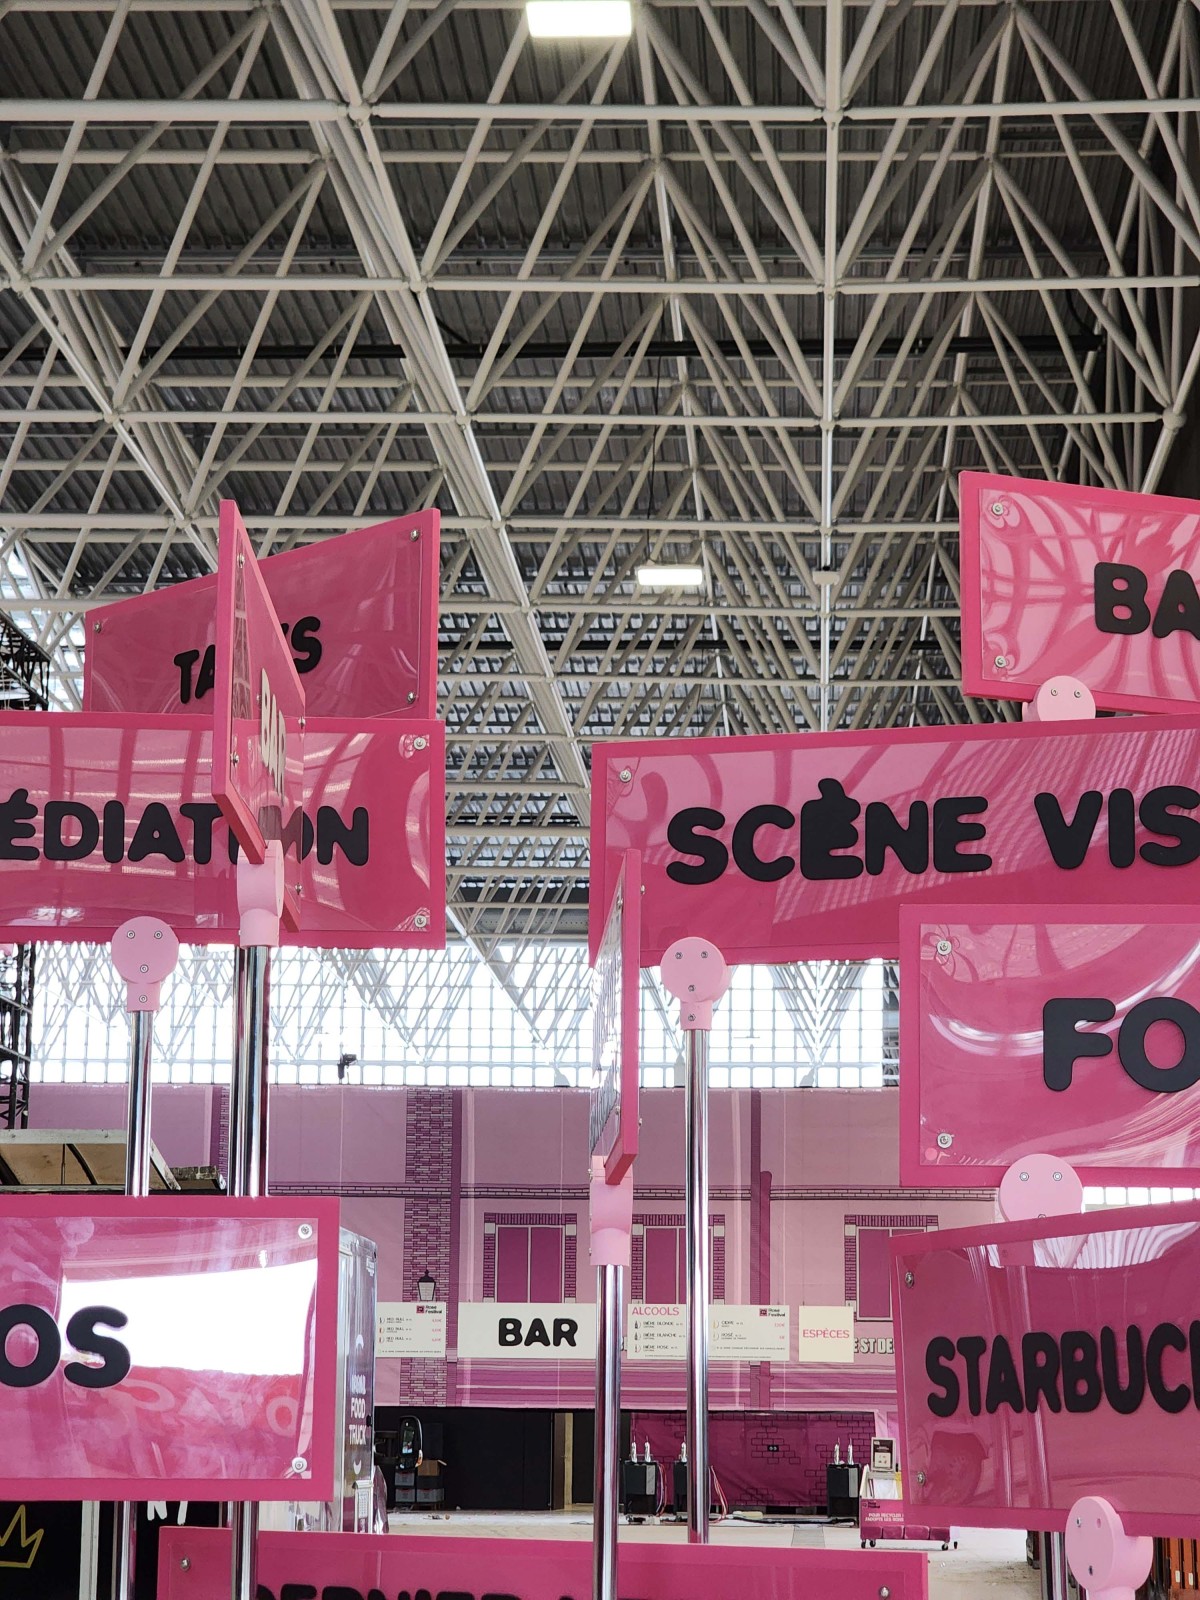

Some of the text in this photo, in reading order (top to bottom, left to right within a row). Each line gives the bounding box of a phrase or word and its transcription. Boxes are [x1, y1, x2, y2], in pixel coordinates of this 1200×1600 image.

[1094, 562, 1200, 641] BA
[0, 788, 369, 866] ÉDIATN
[666, 777, 1200, 885] SCÈNE VIS
[1042, 996, 1200, 1093] FO
[0, 1304, 131, 1388] OS
[498, 1318, 579, 1347] BAR
[632, 1307, 679, 1315] ALCOOLS
[802, 1328, 850, 1339] ESPÈCES
[925, 1320, 1200, 1417] STARBUC
[348, 1424, 367, 1445] TRUCK
[350, 1397, 366, 1419] FOOD
